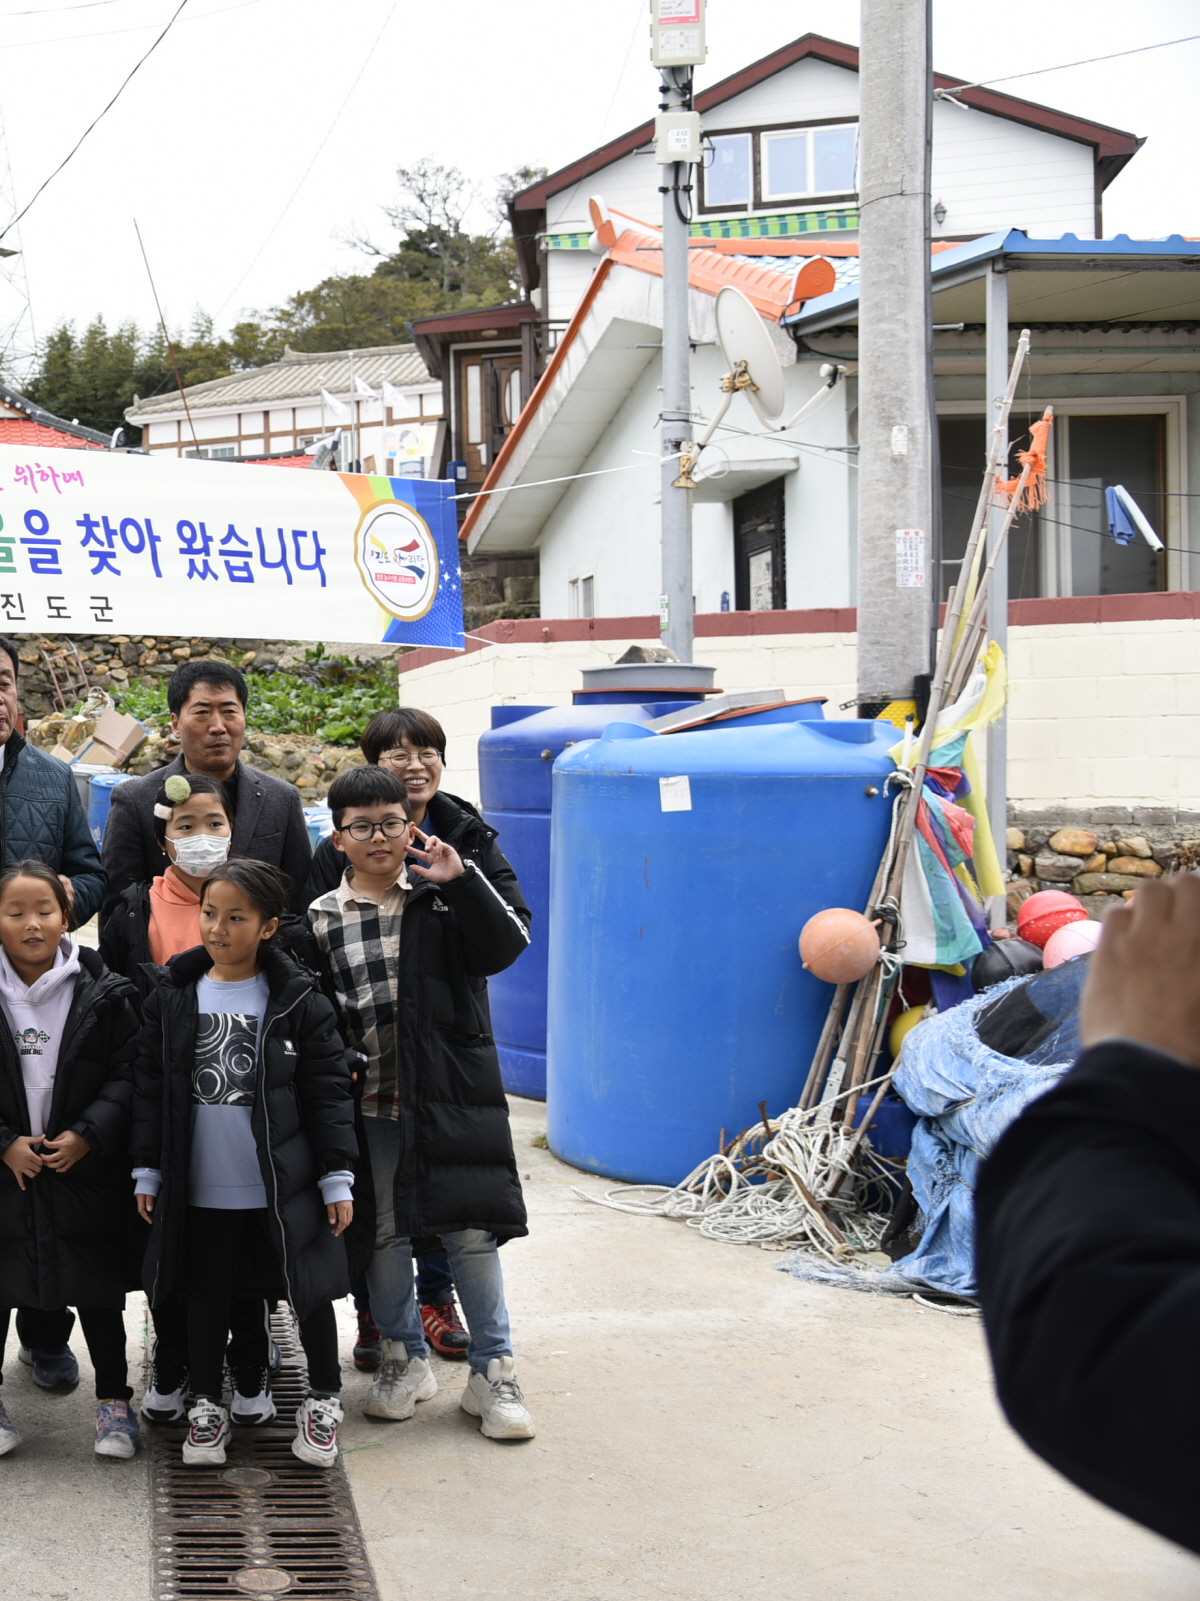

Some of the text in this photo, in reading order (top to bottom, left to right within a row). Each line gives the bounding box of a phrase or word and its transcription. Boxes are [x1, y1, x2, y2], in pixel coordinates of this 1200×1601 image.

[14, 463, 85, 494] 위하여
[75, 514, 163, 579] 찾아
[177, 519, 327, 588] 왔습니다
[318, 1404, 333, 1414] FILA
